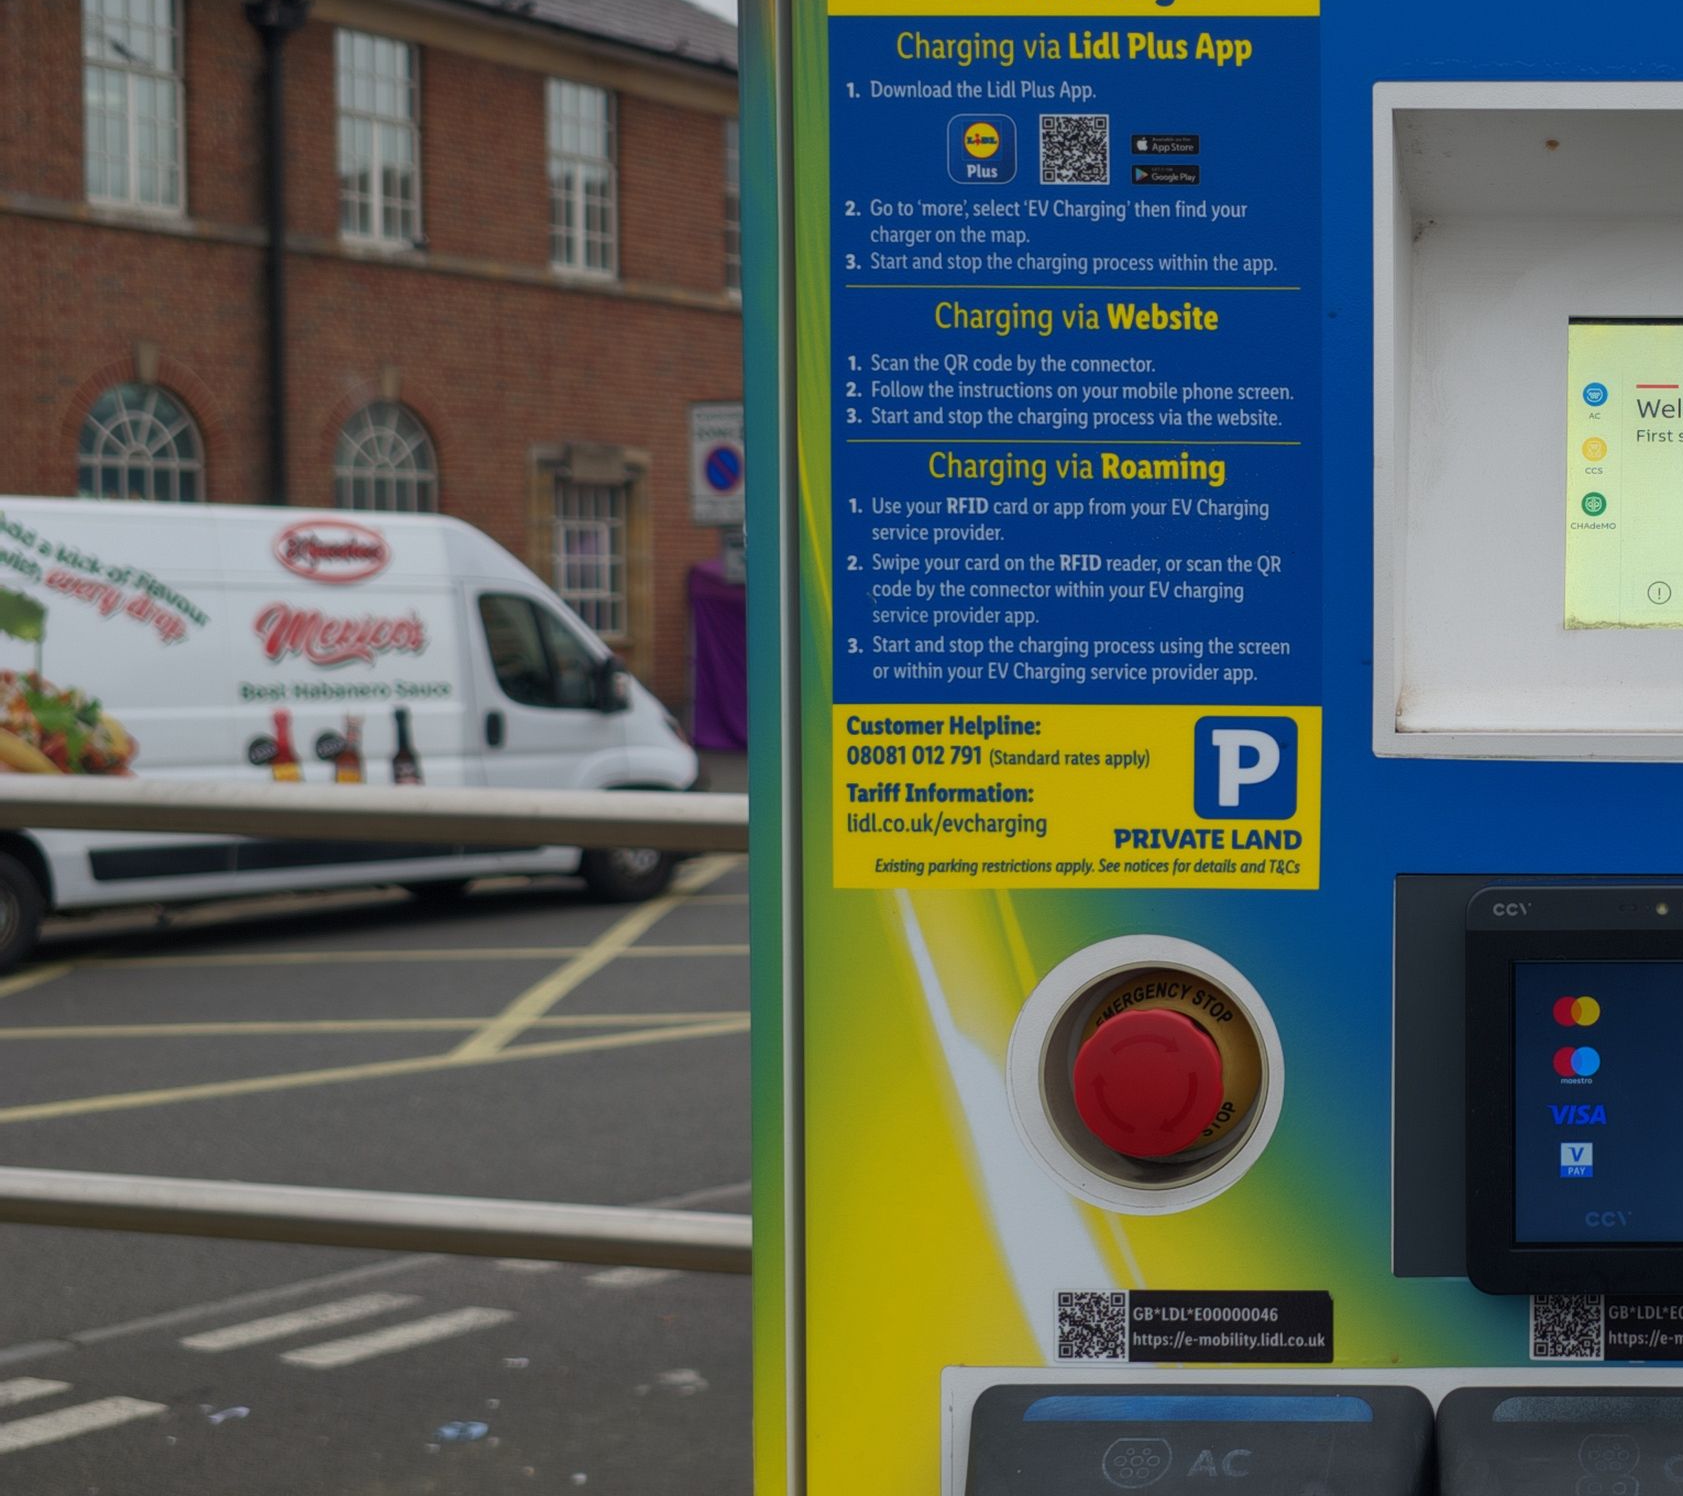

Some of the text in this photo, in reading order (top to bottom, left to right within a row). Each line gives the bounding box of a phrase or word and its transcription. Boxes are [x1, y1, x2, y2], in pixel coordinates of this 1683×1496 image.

[898, 31, 1252, 66] Charging via Lidl Plus App
[847, 81, 1096, 102] 1. Download the Lidl Plus App.
[1152, 142, 1194, 153] App Store
[967, 164, 999, 179] Plus
[1152, 173, 1196, 183] Google Play
[845, 201, 861, 216] 2.
[871, 199, 892, 216] Go
[898, 202, 913, 216] to
[973, 199, 1020, 216] select
[1135, 200, 1170, 217] then
[1176, 200, 1207, 217] find
[1212, 205, 1247, 221] your
[871, 225, 1029, 247] charger on the map.
[936, 302, 1218, 336] Charging via Website
[1637, 429, 1673, 442] First
[930, 452, 1225, 487] Charging via Roaming
[294, 681, 391, 699] Habanero
[395, 680, 451, 698] Sauce
[847, 715, 1040, 739] Customer Helpline:
[847, 745, 1149, 768] 08081 012 791 (Standard rates apply)
[1212, 729, 1279, 806] P
[847, 783, 1033, 802] Tariff Information:
[848, 812, 1047, 838] lidl.co.uk/evcharging
[1113, 828, 1303, 852] PRIVATE LAND
[875, 858, 1300, 876] Existing parking restrictions apply. See notices for details and T&Cs
[1192, 990, 1233, 1024] STOP
[1547, 1104, 1608, 1126] VISA
[1568, 1147, 1585, 1162] V
[1568, 1166, 1586, 1176] PAY
[1133, 1332, 1324, 1349] https://e-mobility.lidl.co.uk
[1187, 1449, 1254, 1477] AC
